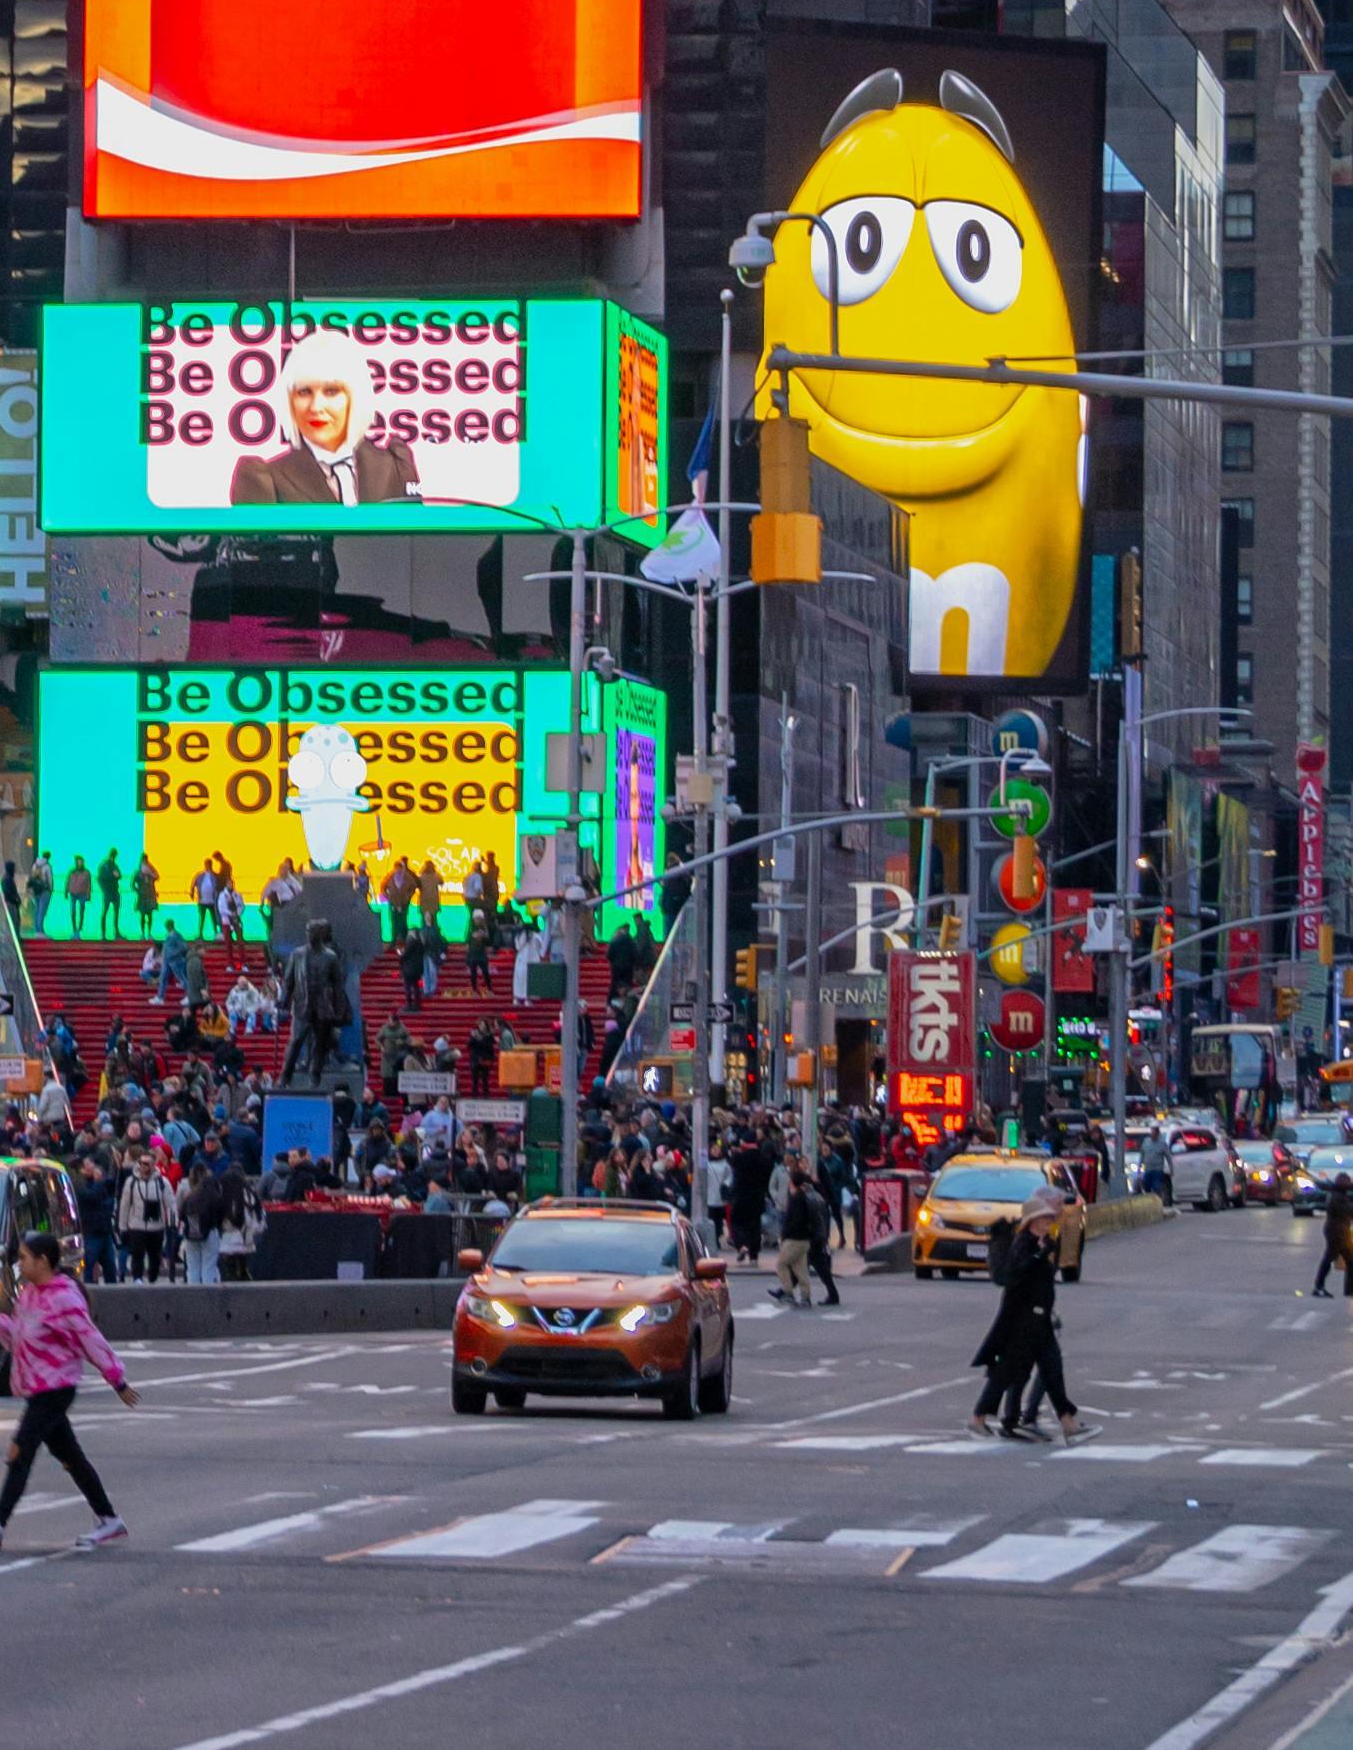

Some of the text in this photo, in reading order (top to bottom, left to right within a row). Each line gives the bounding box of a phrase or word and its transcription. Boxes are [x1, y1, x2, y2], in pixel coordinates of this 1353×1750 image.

[139, 349, 215, 397] Be
[139, 398, 215, 447] Be
[136, 671, 524, 715] Be Obsessed
[136, 720, 210, 765] Be
[999, 730, 1019, 751] m
[136, 769, 210, 815] Be
[848, 881, 917, 975] R
[909, 960, 961, 1063] tkts
[1008, 1009, 1034, 1030] m
